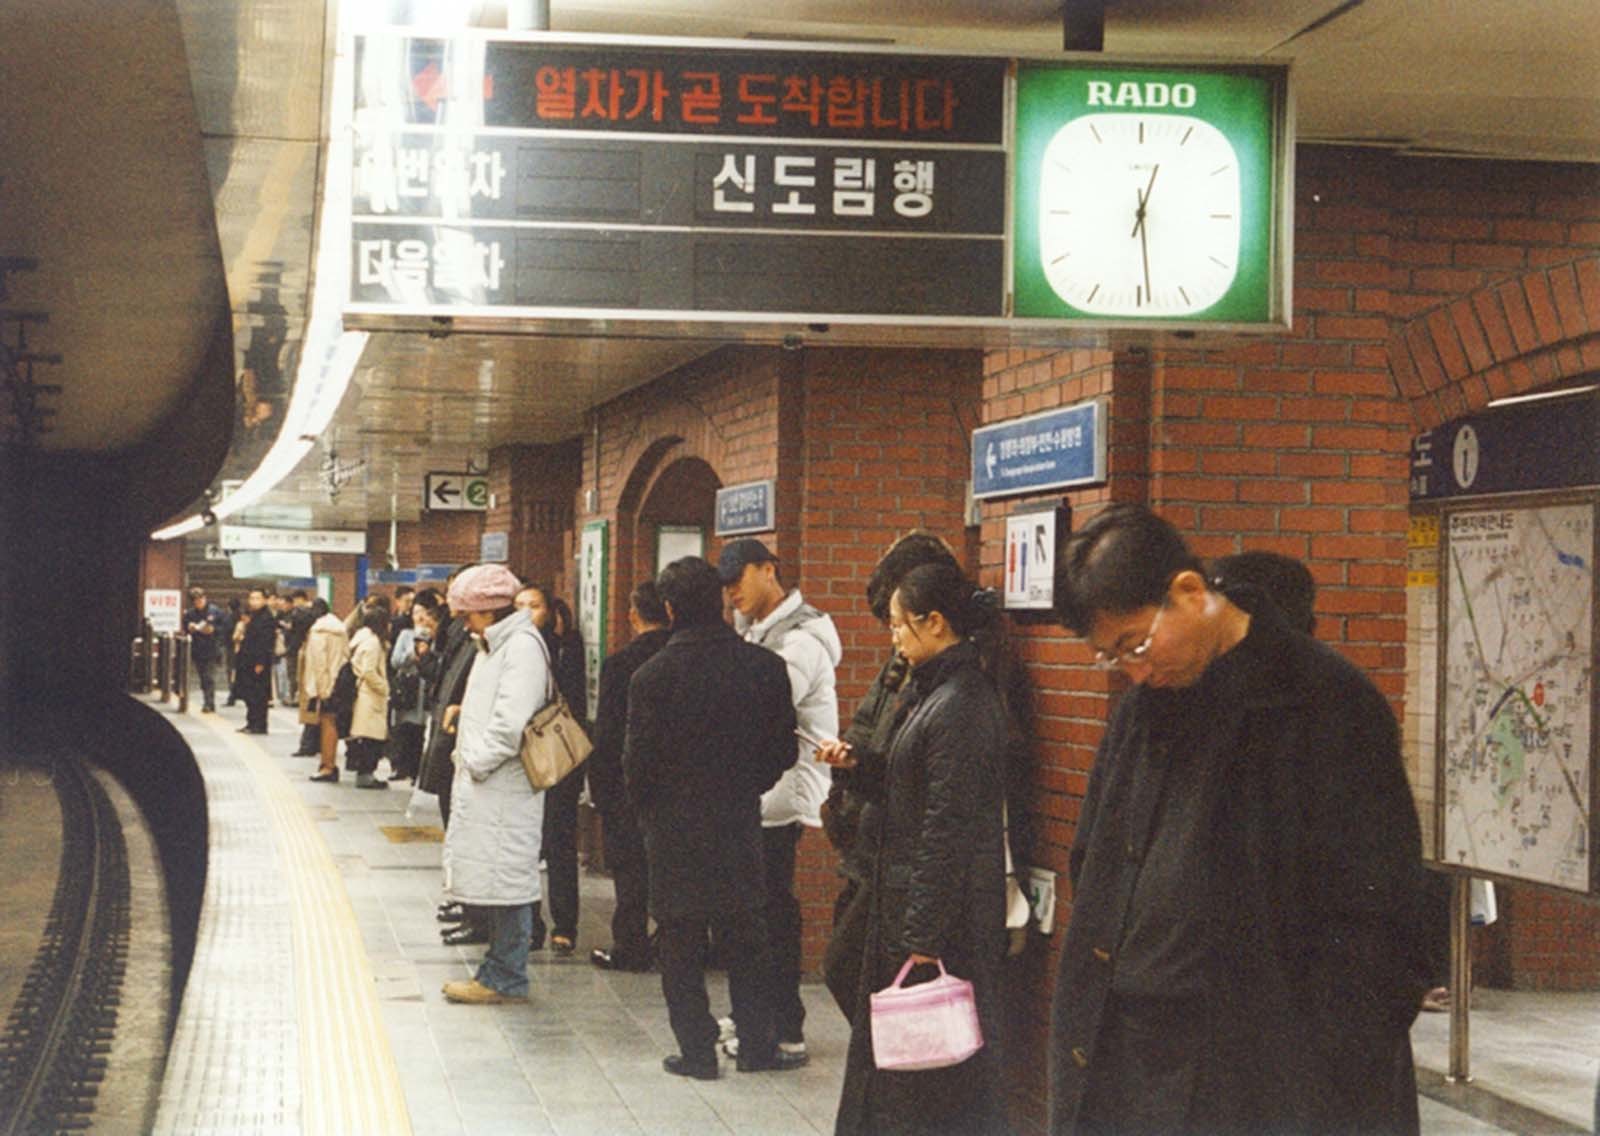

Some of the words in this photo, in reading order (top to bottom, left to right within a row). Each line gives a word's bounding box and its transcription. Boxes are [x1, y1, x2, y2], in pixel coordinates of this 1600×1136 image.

[535, 68, 668, 121] 열차가
[680, 71, 721, 124] 곧
[737, 74, 959, 131] 도착합니다
[1087, 80, 1197, 108] RADO
[358, 149, 507, 201] 번차
[712, 154, 935, 218] 신도림행
[358, 239, 506, 290] 다음열차
